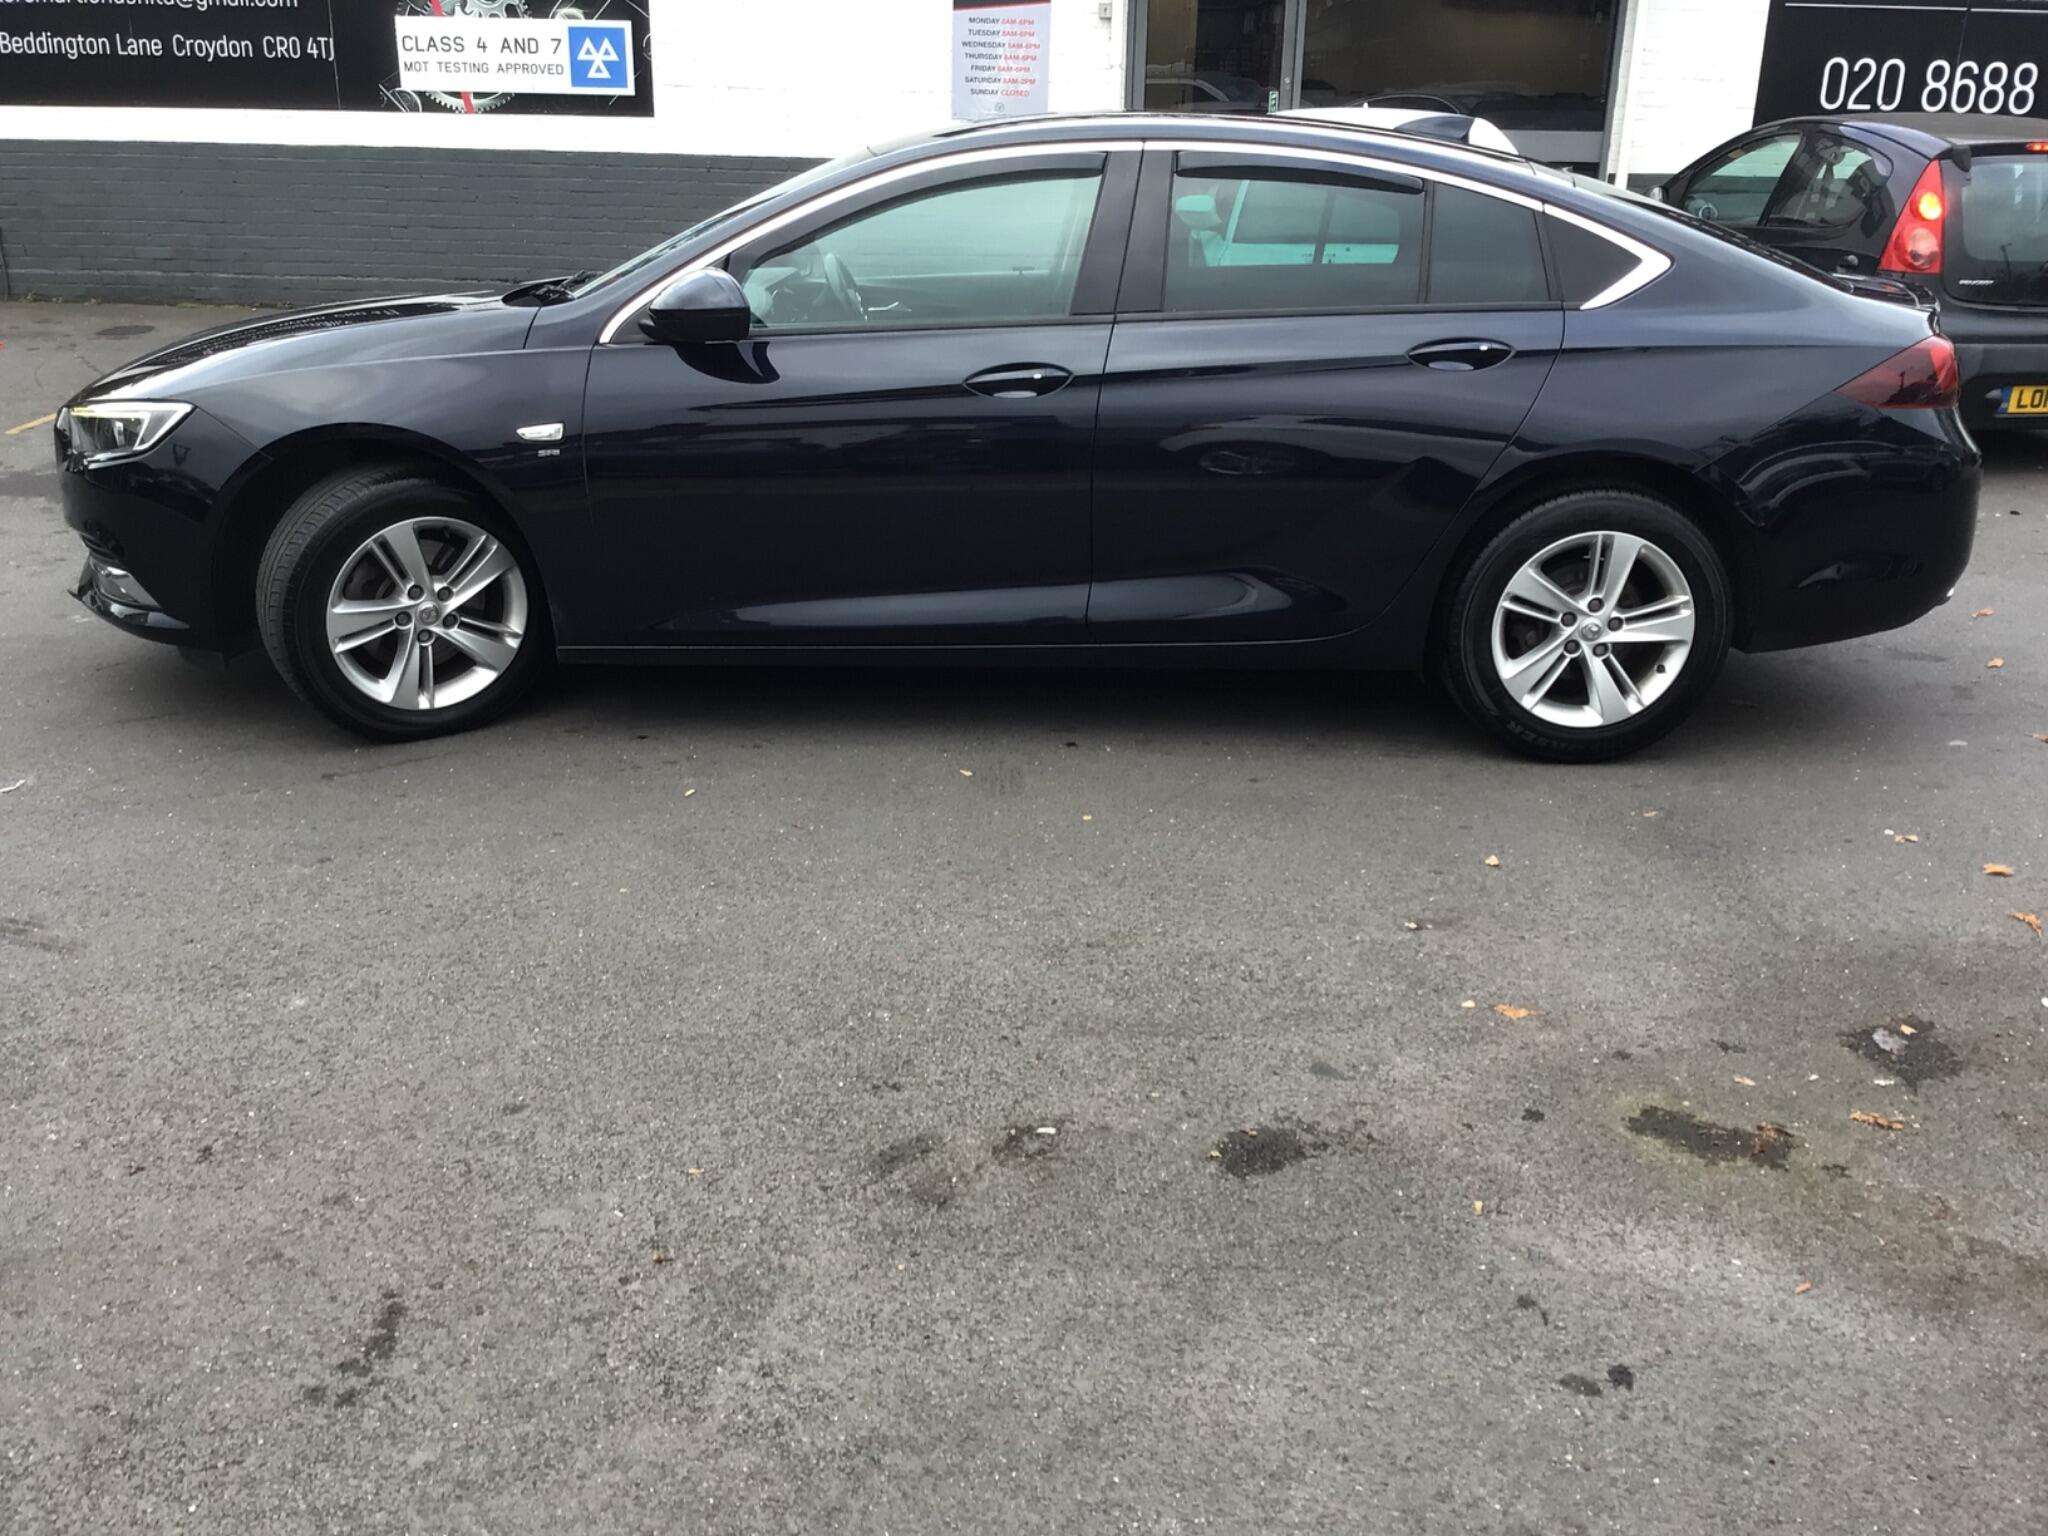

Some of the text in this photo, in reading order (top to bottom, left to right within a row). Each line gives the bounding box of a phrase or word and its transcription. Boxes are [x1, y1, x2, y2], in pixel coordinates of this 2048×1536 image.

[0, 32, 110, 60] Beddington
[116, 33, 163, 57] Lane
[172, 34, 253, 62] Croydon
[306, 36, 335, 61] 4TJ
[402, 35, 562, 55] CLASS 4 AND 7
[404, 61, 564, 76] MOT TESTING APPROVED
[970, 88, 999, 96] SUNDAY
[1819, 56, 2039, 115] 020 8688
